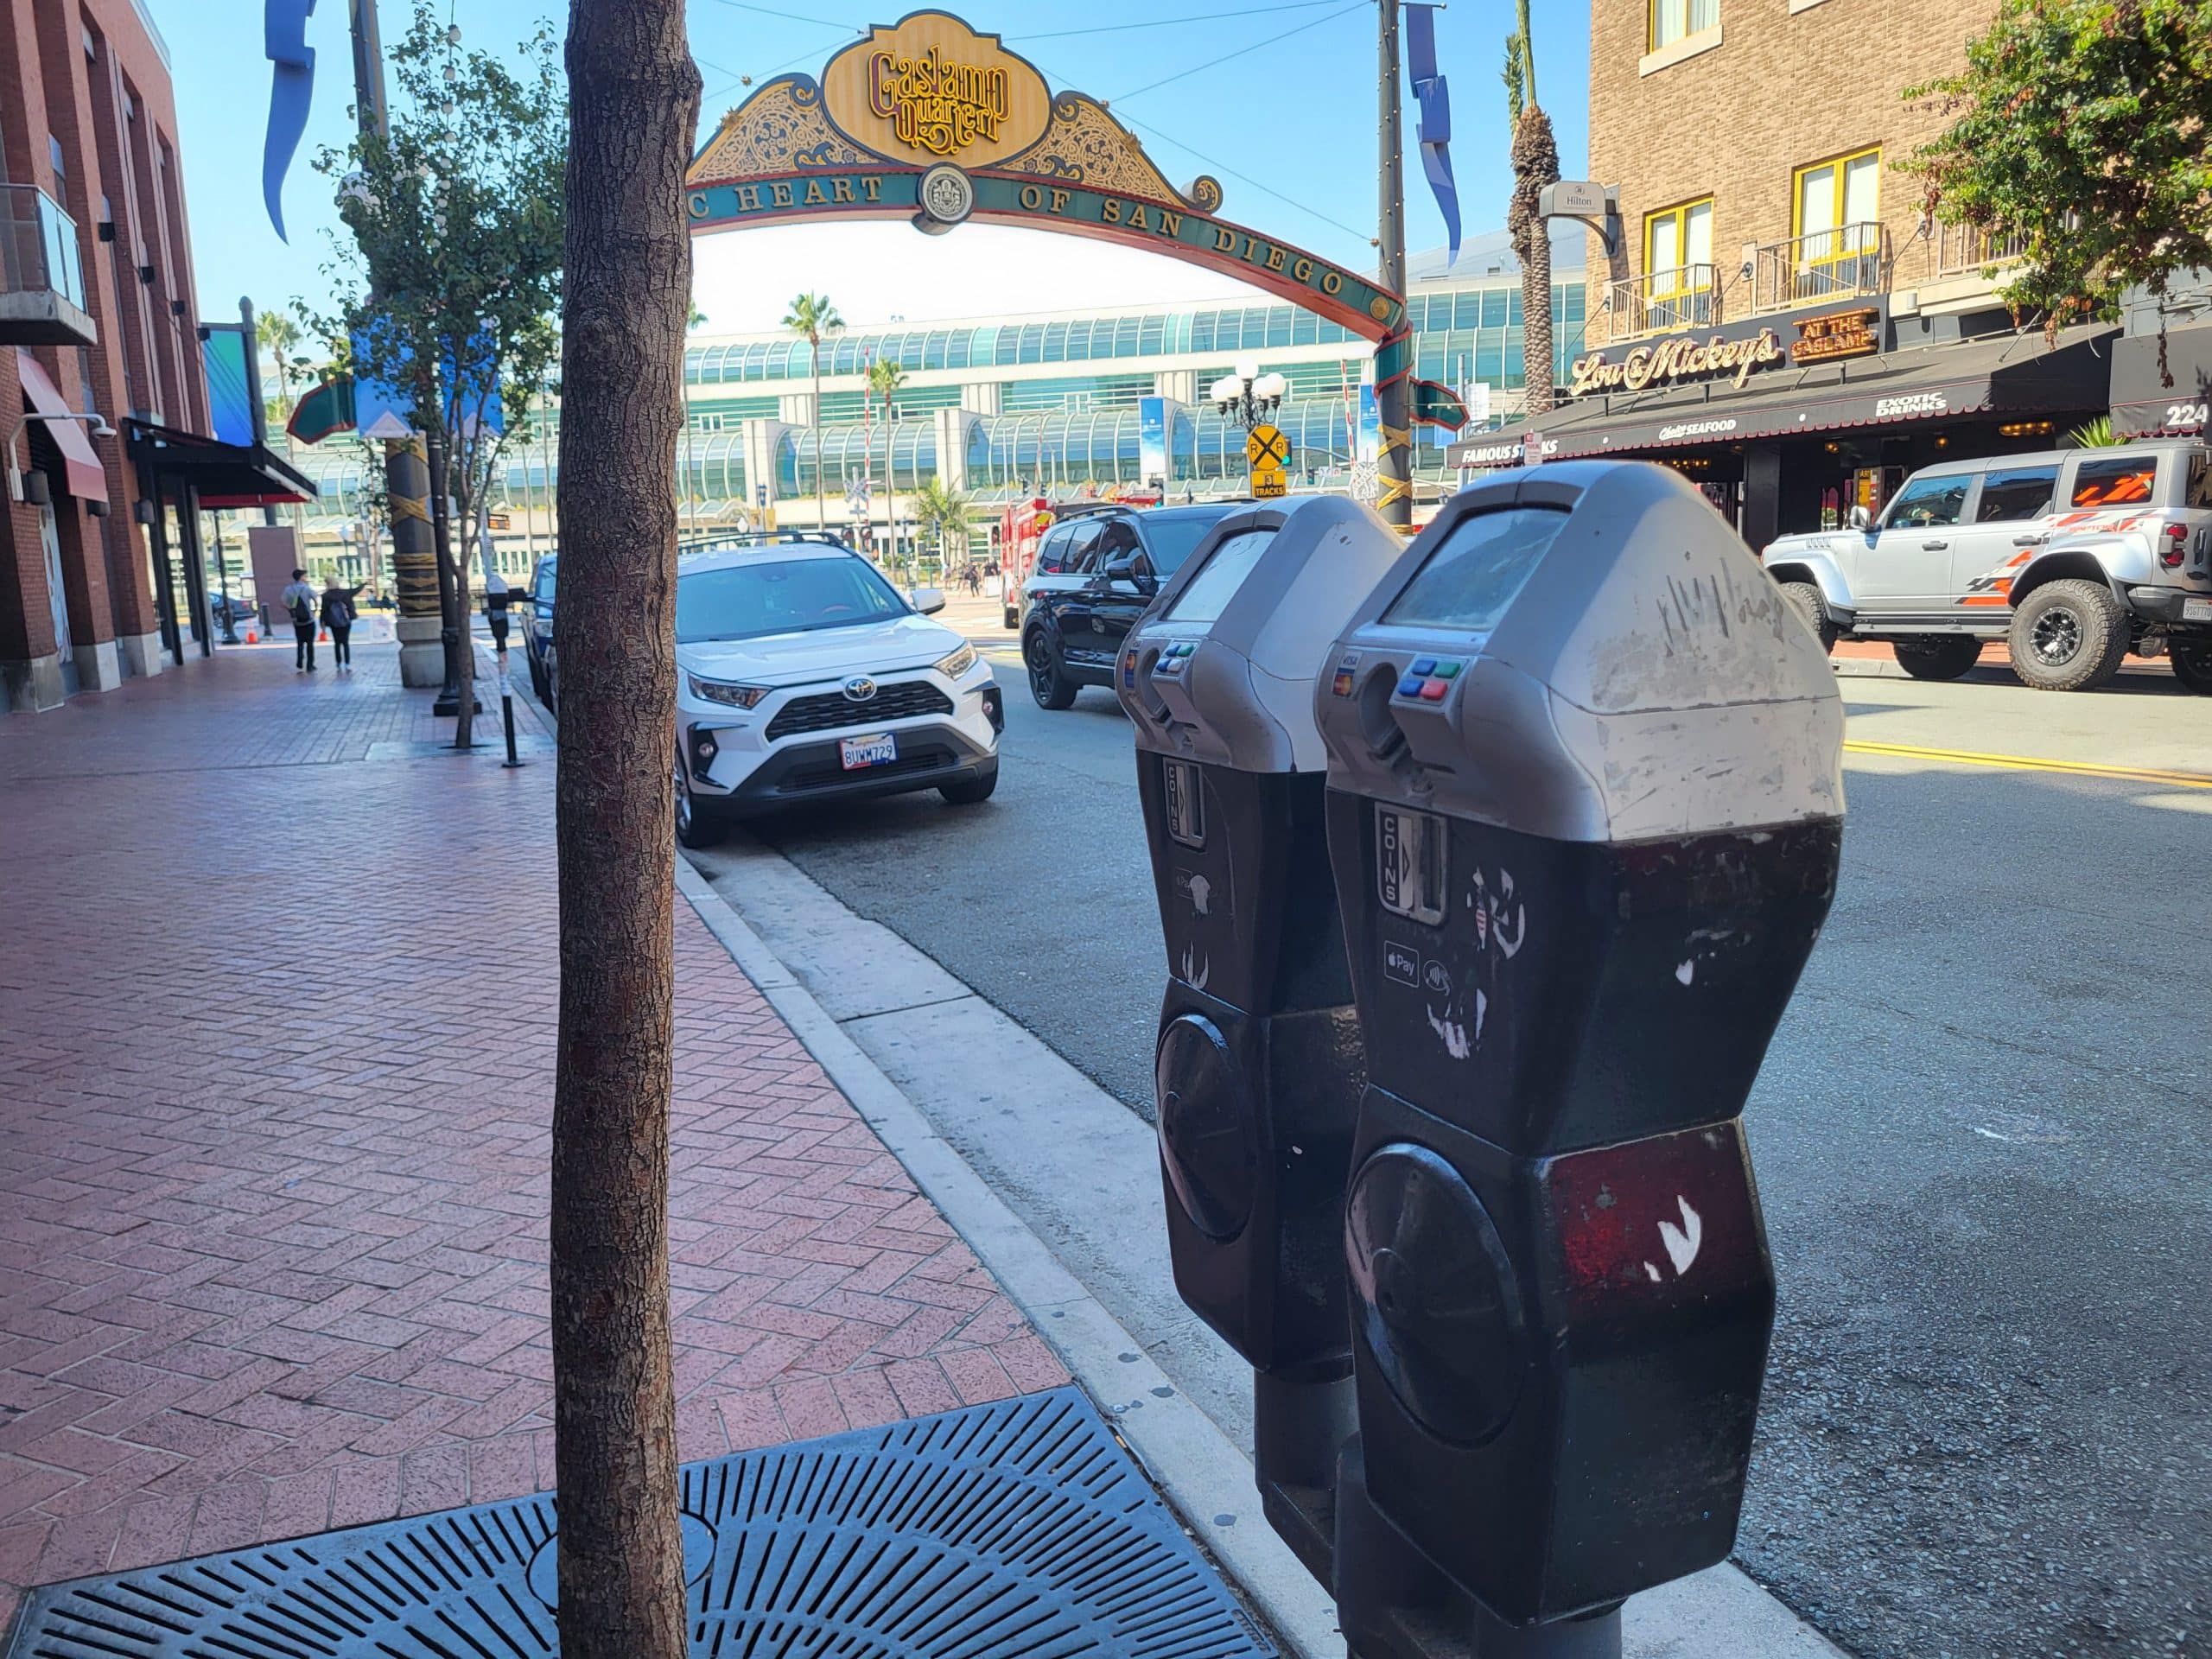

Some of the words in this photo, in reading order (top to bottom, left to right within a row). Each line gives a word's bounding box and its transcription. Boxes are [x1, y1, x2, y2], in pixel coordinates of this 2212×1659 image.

[868, 44, 1011, 121] Gaslamp
[895, 98, 1000, 155] Quarter
[1567, 196, 1592, 207] Hilton
[734, 175, 883, 213] HEART
[1018, 186, 1071, 213] OF
[1102, 198, 1183, 238] SAN
[1214, 228, 1343, 296] DIEGO
[1802, 321, 1825, 339] AT
[1828, 315, 1861, 334] THE
[1790, 330, 1877, 357] GASLAMP
[1570, 352, 1625, 397] Lou
[1624, 327, 1785, 391] Mickey's
[1875, 399, 1947, 416] DRINKS
[1877, 392, 1942, 409] EXOTIC
[2166, 404, 2209, 426] 224
[1686, 419, 1737, 435] SEAFOOD
[1250, 443, 1258, 454] R
[1276, 442, 1284, 452] R
[1462, 445, 1511, 463] FAMOUS
[1512, 440, 1559, 458] STKS
[1255, 486, 1285, 497] TRACKS
[1266, 475, 1273, 485] 3
[844, 745, 893, 765] 8UWM729
[1168, 766, 1179, 830] COINS
[1384, 817, 1396, 901] COINS
[1396, 953, 1415, 976] Pay
